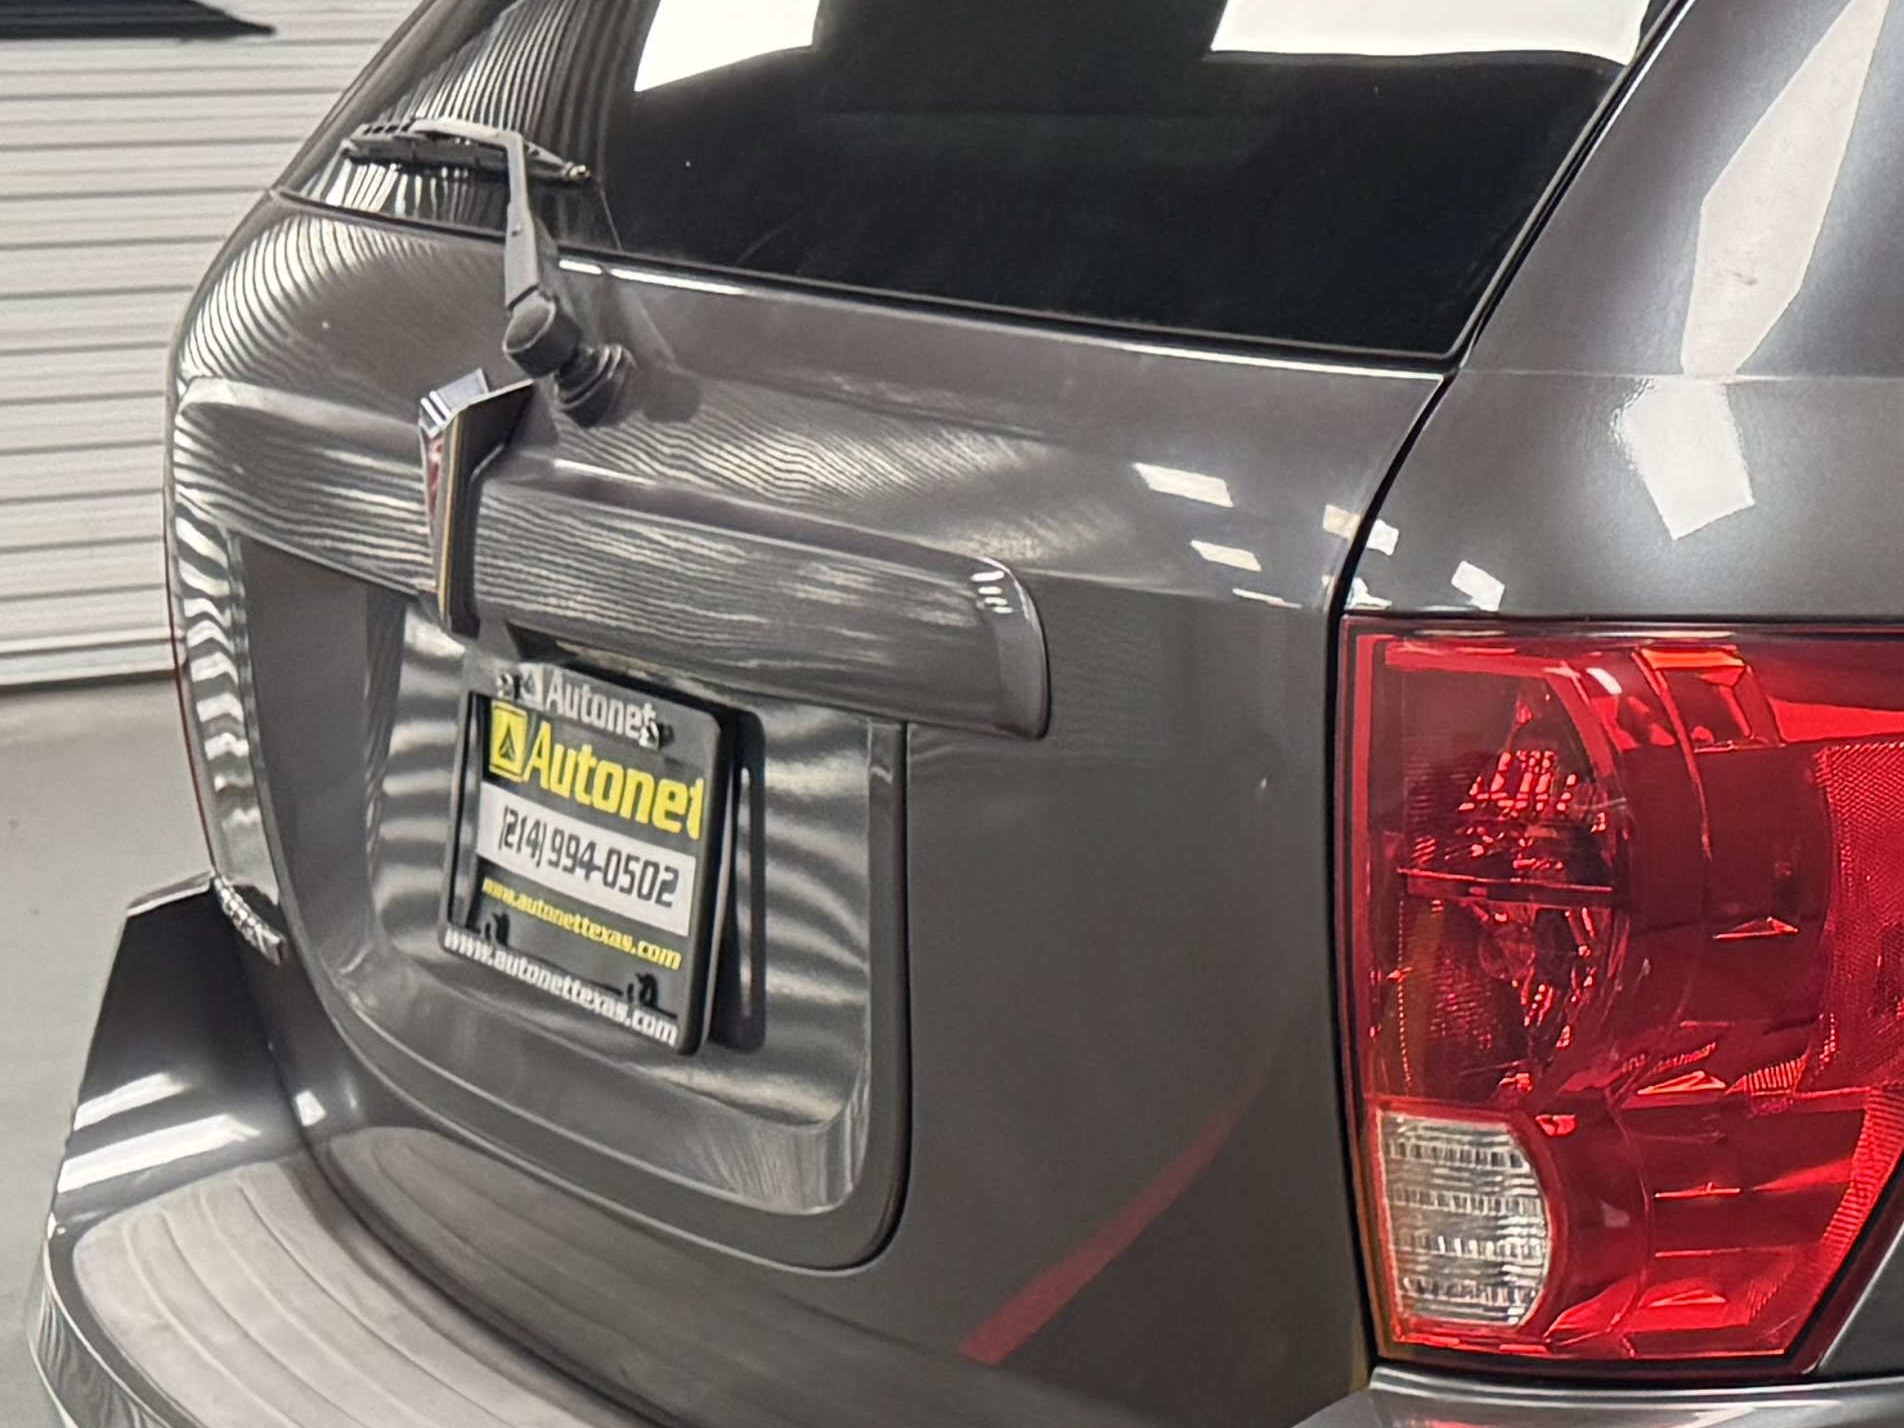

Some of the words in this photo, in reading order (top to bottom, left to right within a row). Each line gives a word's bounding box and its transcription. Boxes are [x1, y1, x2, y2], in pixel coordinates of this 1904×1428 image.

[522, 720, 704, 840] Autonet
[547, 826, 680, 909] 994-0502
[481, 877, 683, 971] www.autonettexas.com
[443, 928, 679, 1047] www.autonettexas.com
